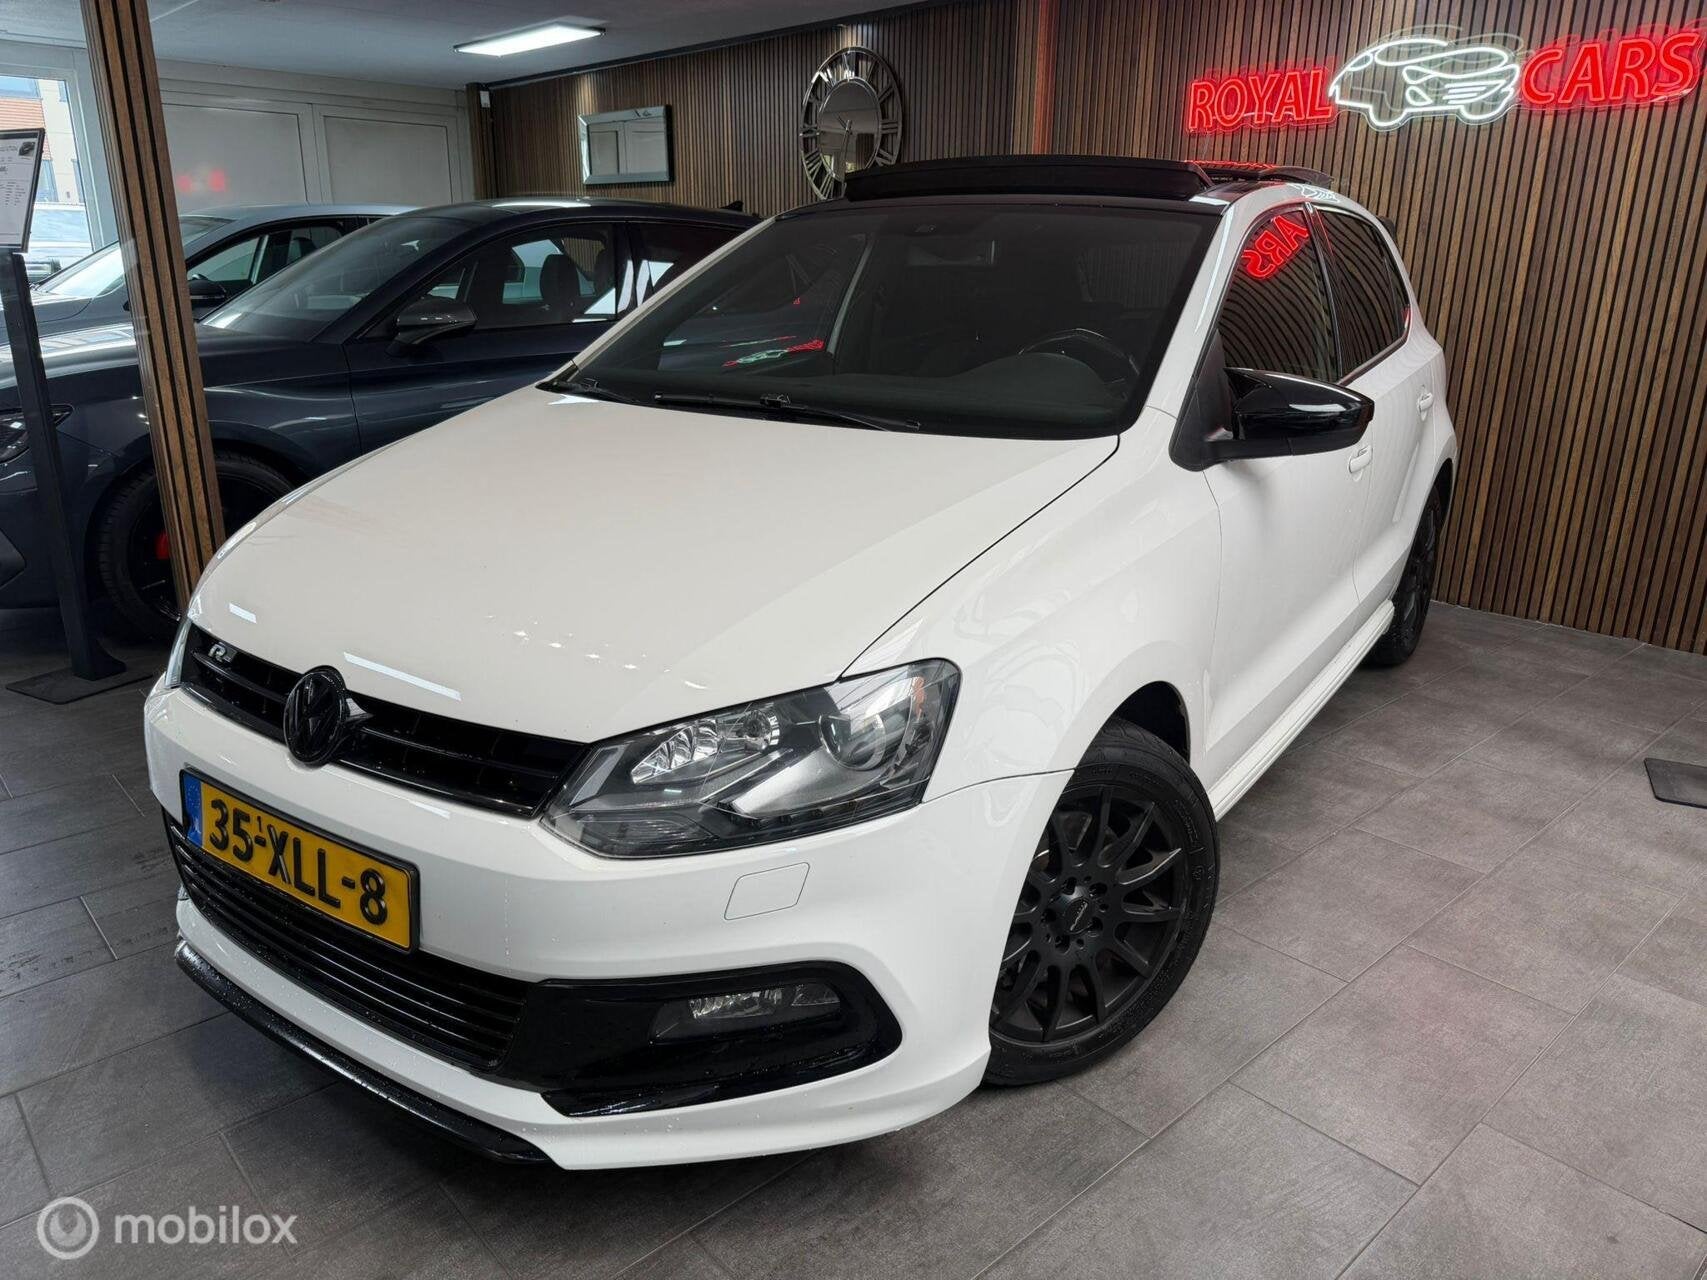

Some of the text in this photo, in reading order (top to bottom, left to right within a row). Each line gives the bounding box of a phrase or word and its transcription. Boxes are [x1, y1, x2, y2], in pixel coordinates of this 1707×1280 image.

[1187, 31, 1700, 132] ROYAL CARS
[209, 798, 388, 926] 35-XLL-8
